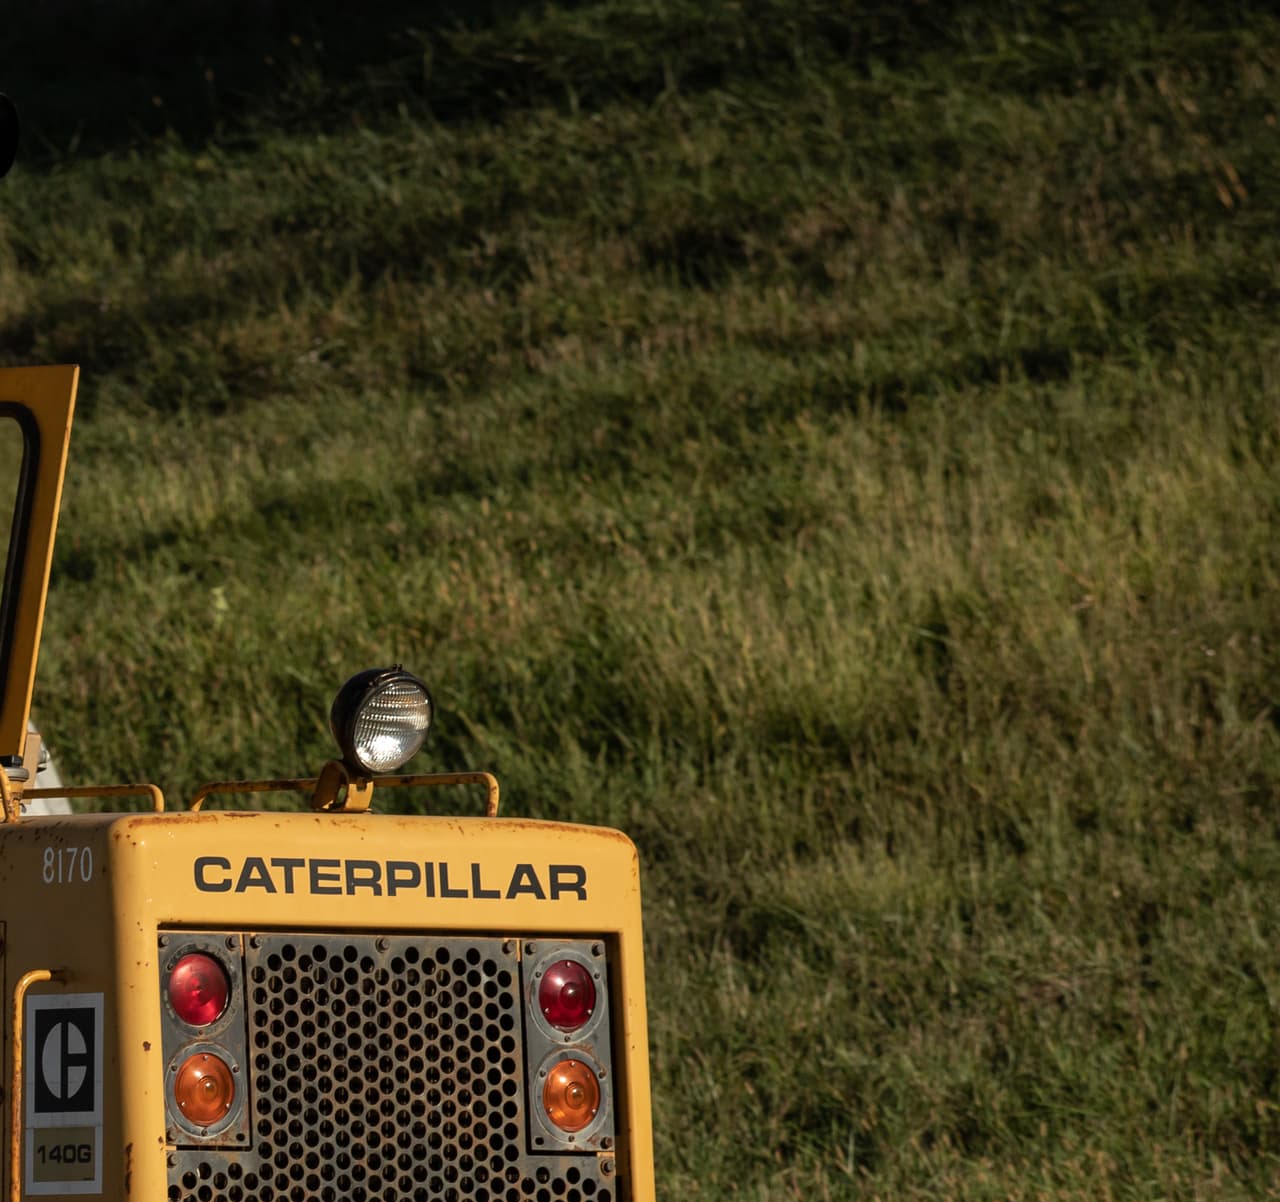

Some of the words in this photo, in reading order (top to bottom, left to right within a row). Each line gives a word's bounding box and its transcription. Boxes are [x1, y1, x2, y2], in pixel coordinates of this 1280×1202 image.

[42, 846, 93, 884] 8170
[192, 855, 588, 901] CATERPILLAR
[37, 1143, 92, 1164] 140G
